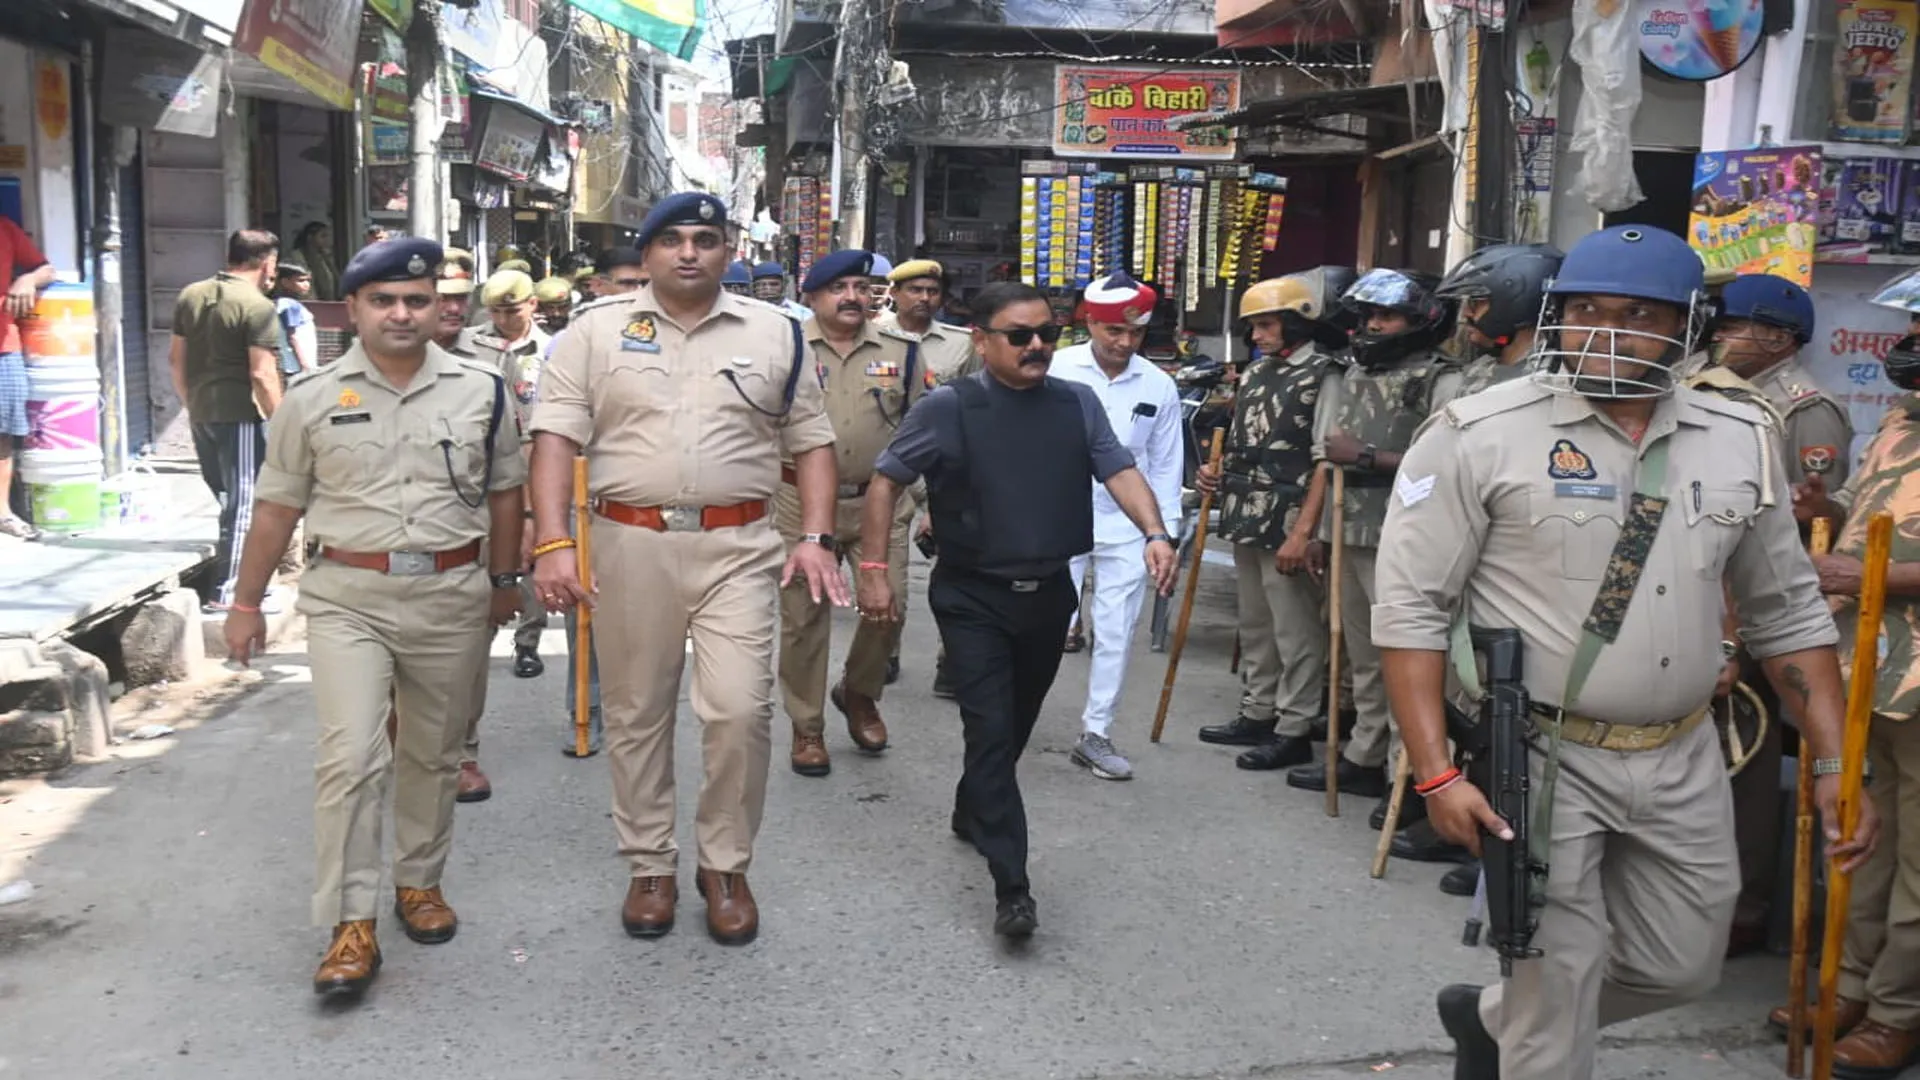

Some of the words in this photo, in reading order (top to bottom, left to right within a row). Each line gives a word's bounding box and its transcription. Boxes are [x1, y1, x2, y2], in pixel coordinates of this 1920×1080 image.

[1846, 32, 1899, 50] JEETO
[1144, 84, 1207, 110] बिहारी
[1847, 363, 1879, 385] दूध
